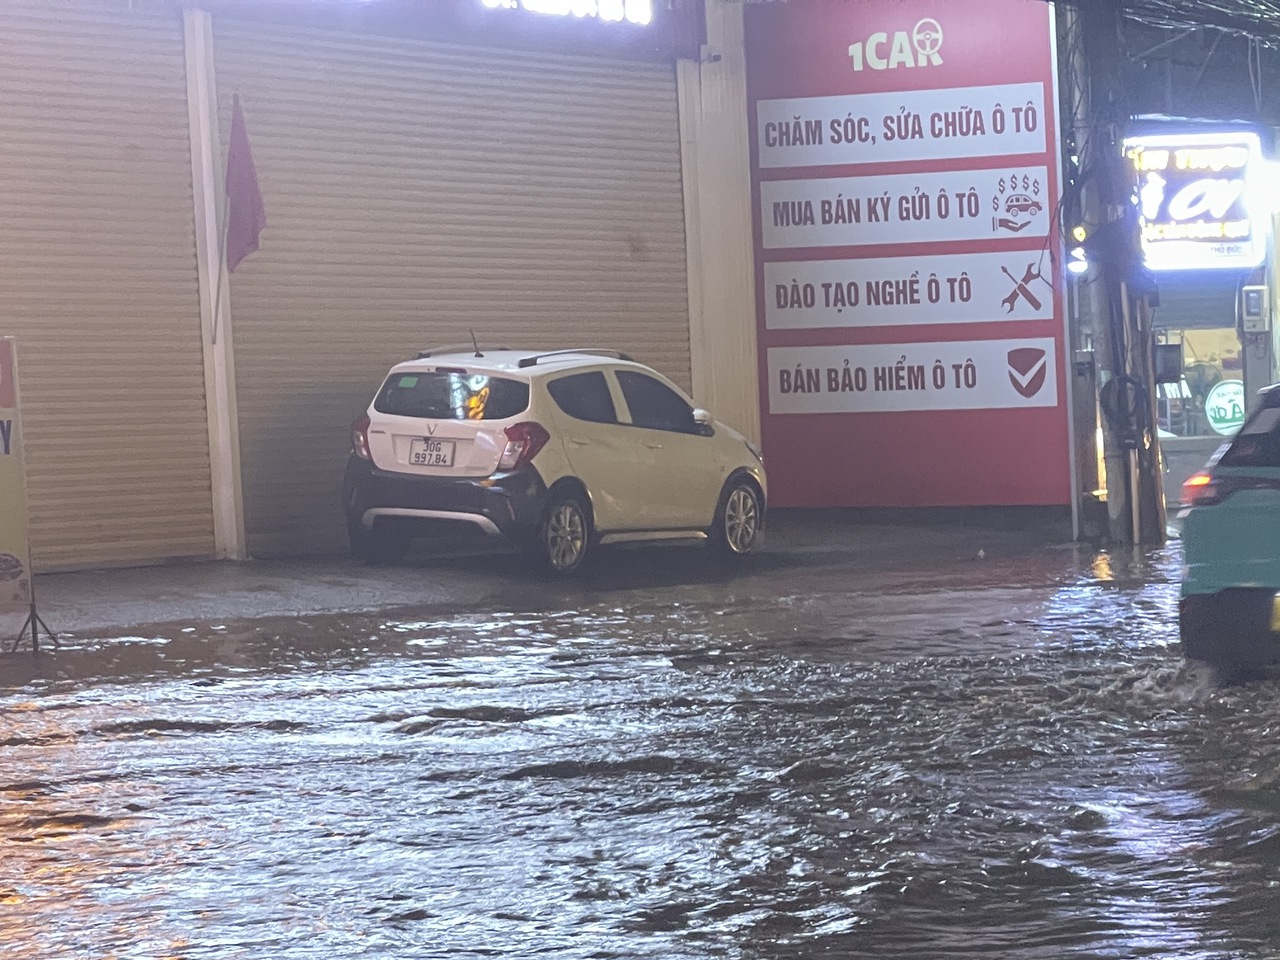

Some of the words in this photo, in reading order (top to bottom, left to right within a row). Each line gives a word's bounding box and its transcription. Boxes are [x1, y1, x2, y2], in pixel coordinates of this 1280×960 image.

[848, 18, 944, 71] 1CAR
[764, 115, 822, 148] CHĂM
[830, 112, 876, 145] SÓC,
[883, 105, 924, 141] SỬA
[930, 105, 985, 139] CHỮA
[992, 103, 1005, 134] Ô
[1012, 101, 1037, 133] TÔ
[773, 201, 815, 228] MUA
[821, 193, 861, 225] BÁN
[867, 191, 892, 222] KÝ
[899, 186, 930, 221] GỬI
[937, 188, 950, 220] Ô
[955, 186, 980, 218] TÔ
[776, 279, 815, 309] ĐÀO
[821, 281, 859, 313] TẠO
[866, 271, 920, 306] NGHỀ
[927, 273, 940, 304] Ô
[947, 272, 972, 303] TÔ
[779, 363, 820, 394] BÁN
[827, 358, 867, 392] BẢO
[874, 355, 926, 392] HIỂM
[933, 359, 945, 390] Ô
[952, 358, 976, 389] TÔ
[414, 453, 447, 464] 997.84
